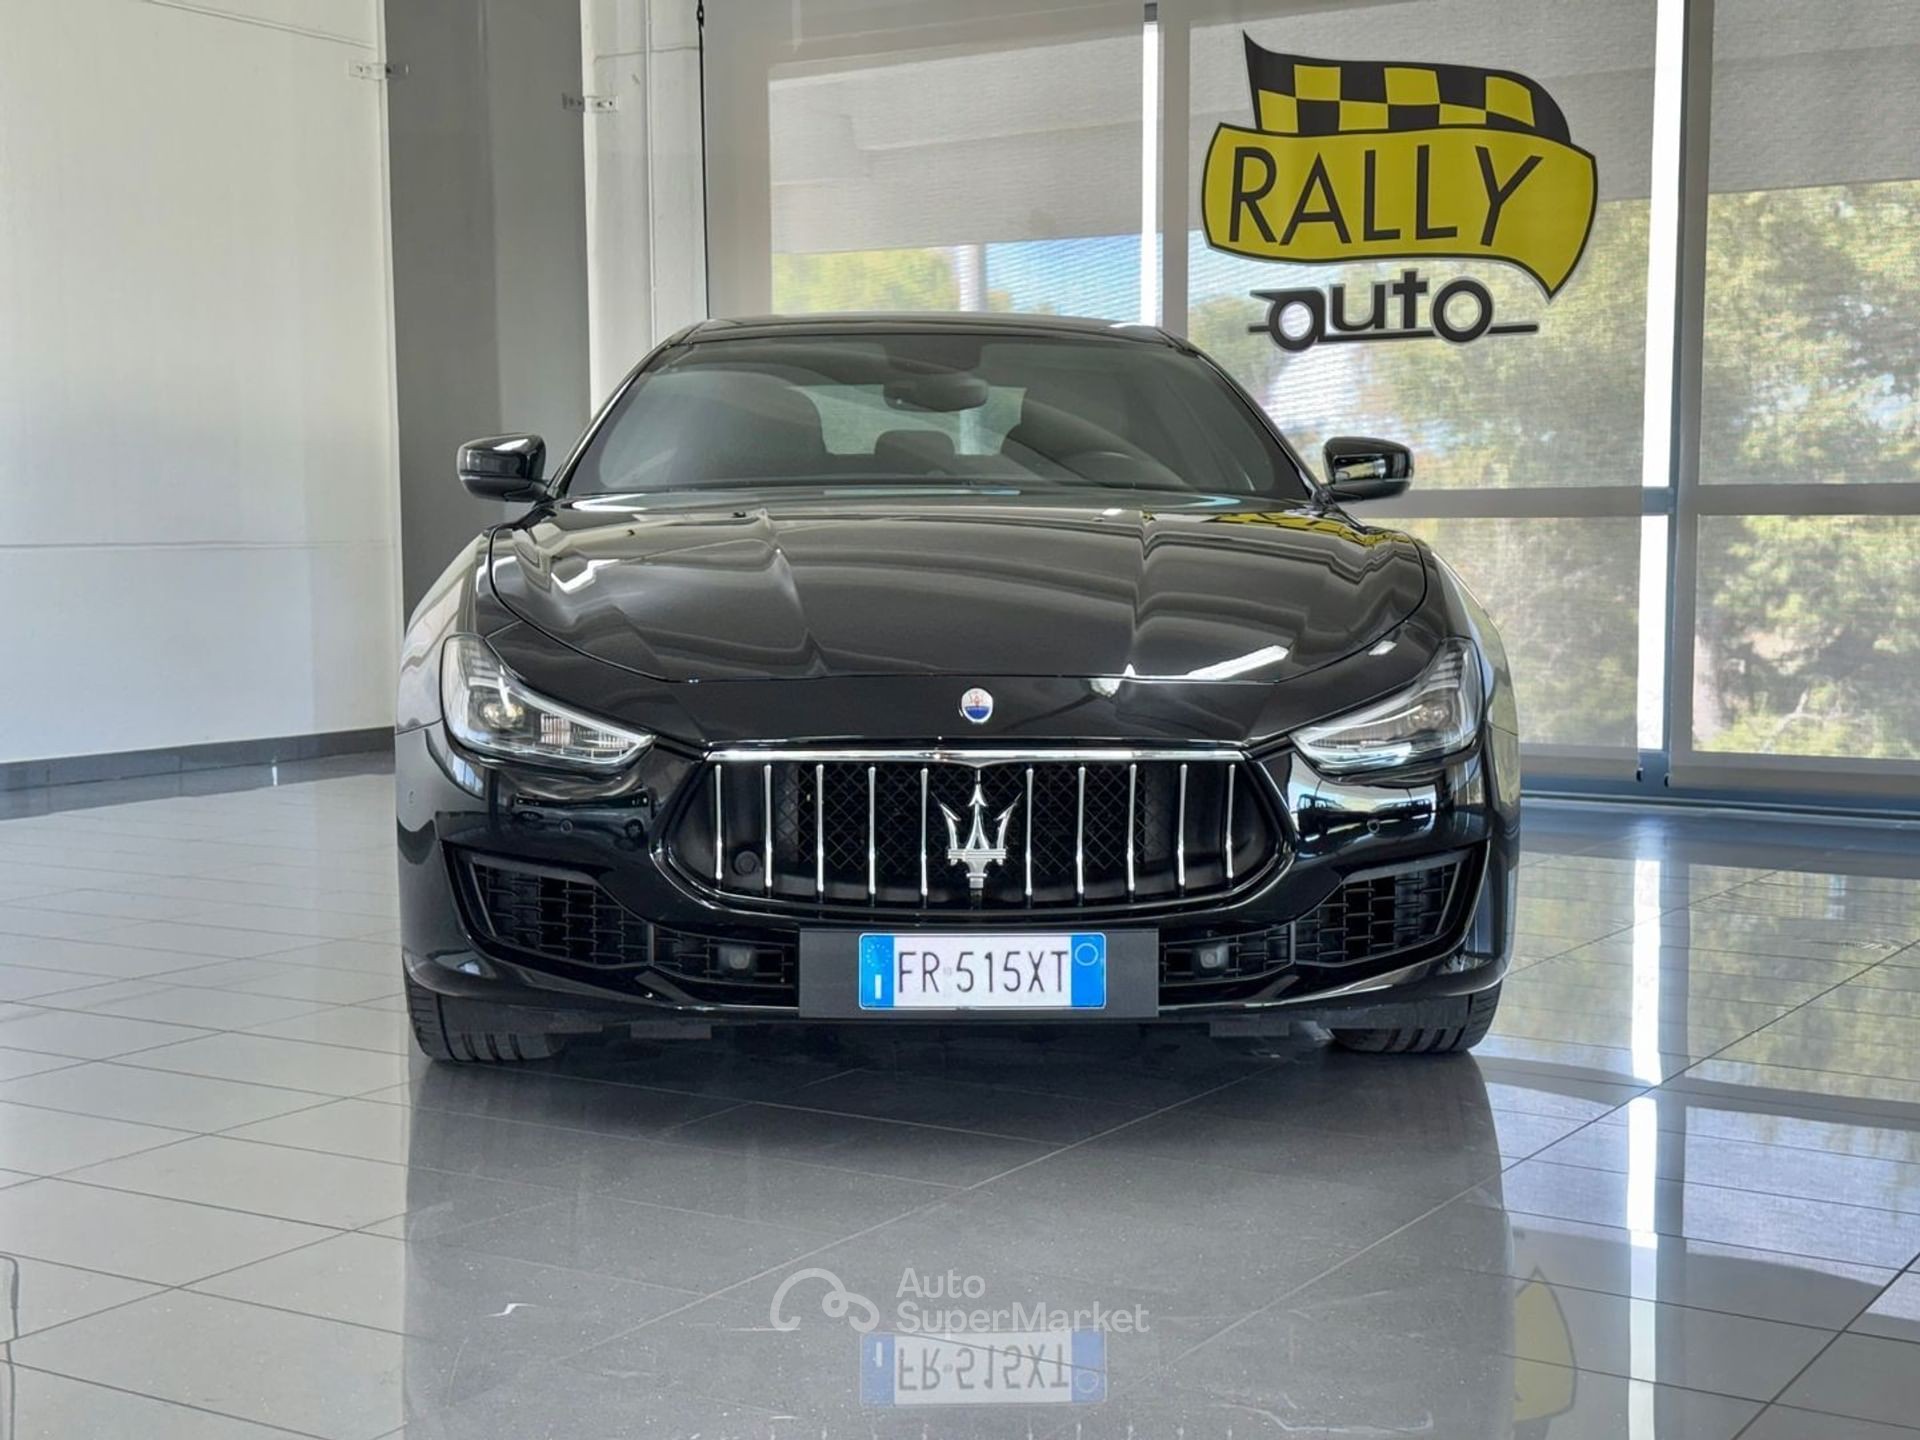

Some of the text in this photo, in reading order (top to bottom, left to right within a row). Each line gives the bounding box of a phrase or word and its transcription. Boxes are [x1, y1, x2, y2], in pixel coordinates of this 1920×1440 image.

[1228, 144, 1544, 247] RALLY
[1250, 268, 1496, 353] auto
[898, 950, 1069, 993] FR 515XT
